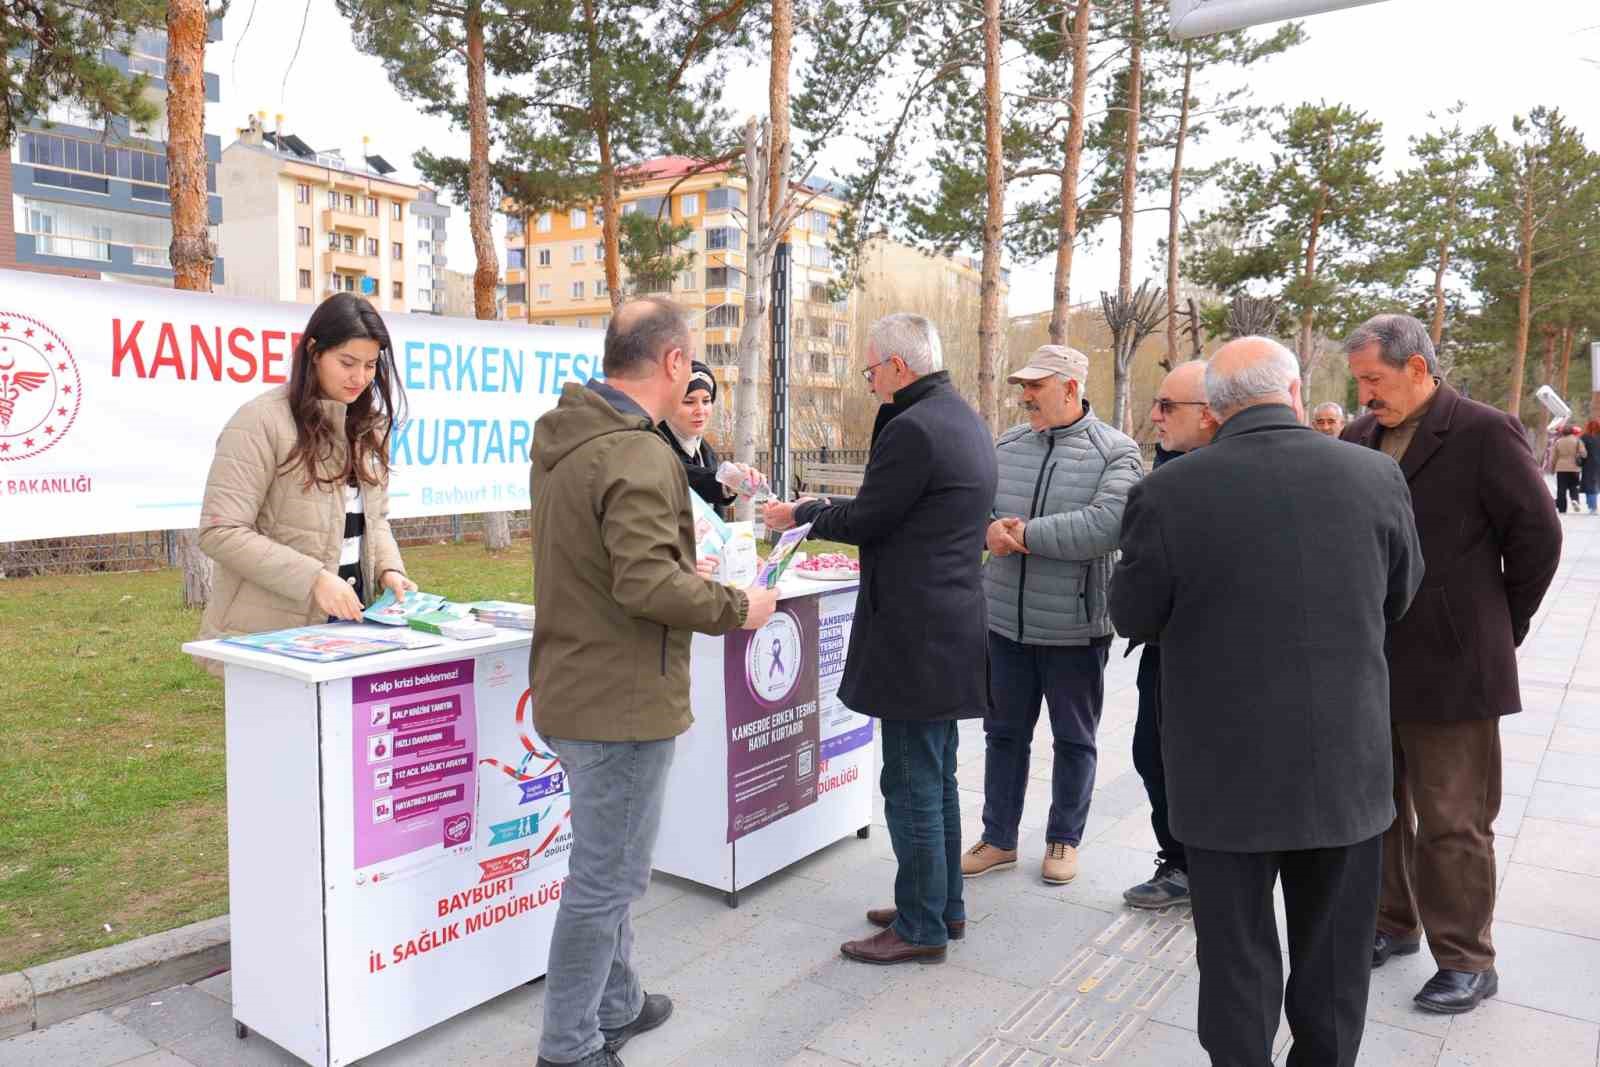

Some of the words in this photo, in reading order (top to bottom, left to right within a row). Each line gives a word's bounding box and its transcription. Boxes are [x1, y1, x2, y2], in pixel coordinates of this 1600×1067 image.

[405, 341, 524, 393] ERKEN
[7, 474, 92, 496] BAKANLIĞI
[370, 682, 393, 694] Kalp
[394, 676, 414, 689] krizi
[415, 669, 459, 686] beklemez!
[732, 716, 771, 742] KANSERDE
[772, 708, 794, 727] ERKEN
[748, 732, 770, 752] HAYAT
[368, 950, 387, 974] İL
[392, 923, 460, 964] SAĞLIK
[465, 879, 566, 935] MÜDÜRLÜĞ
